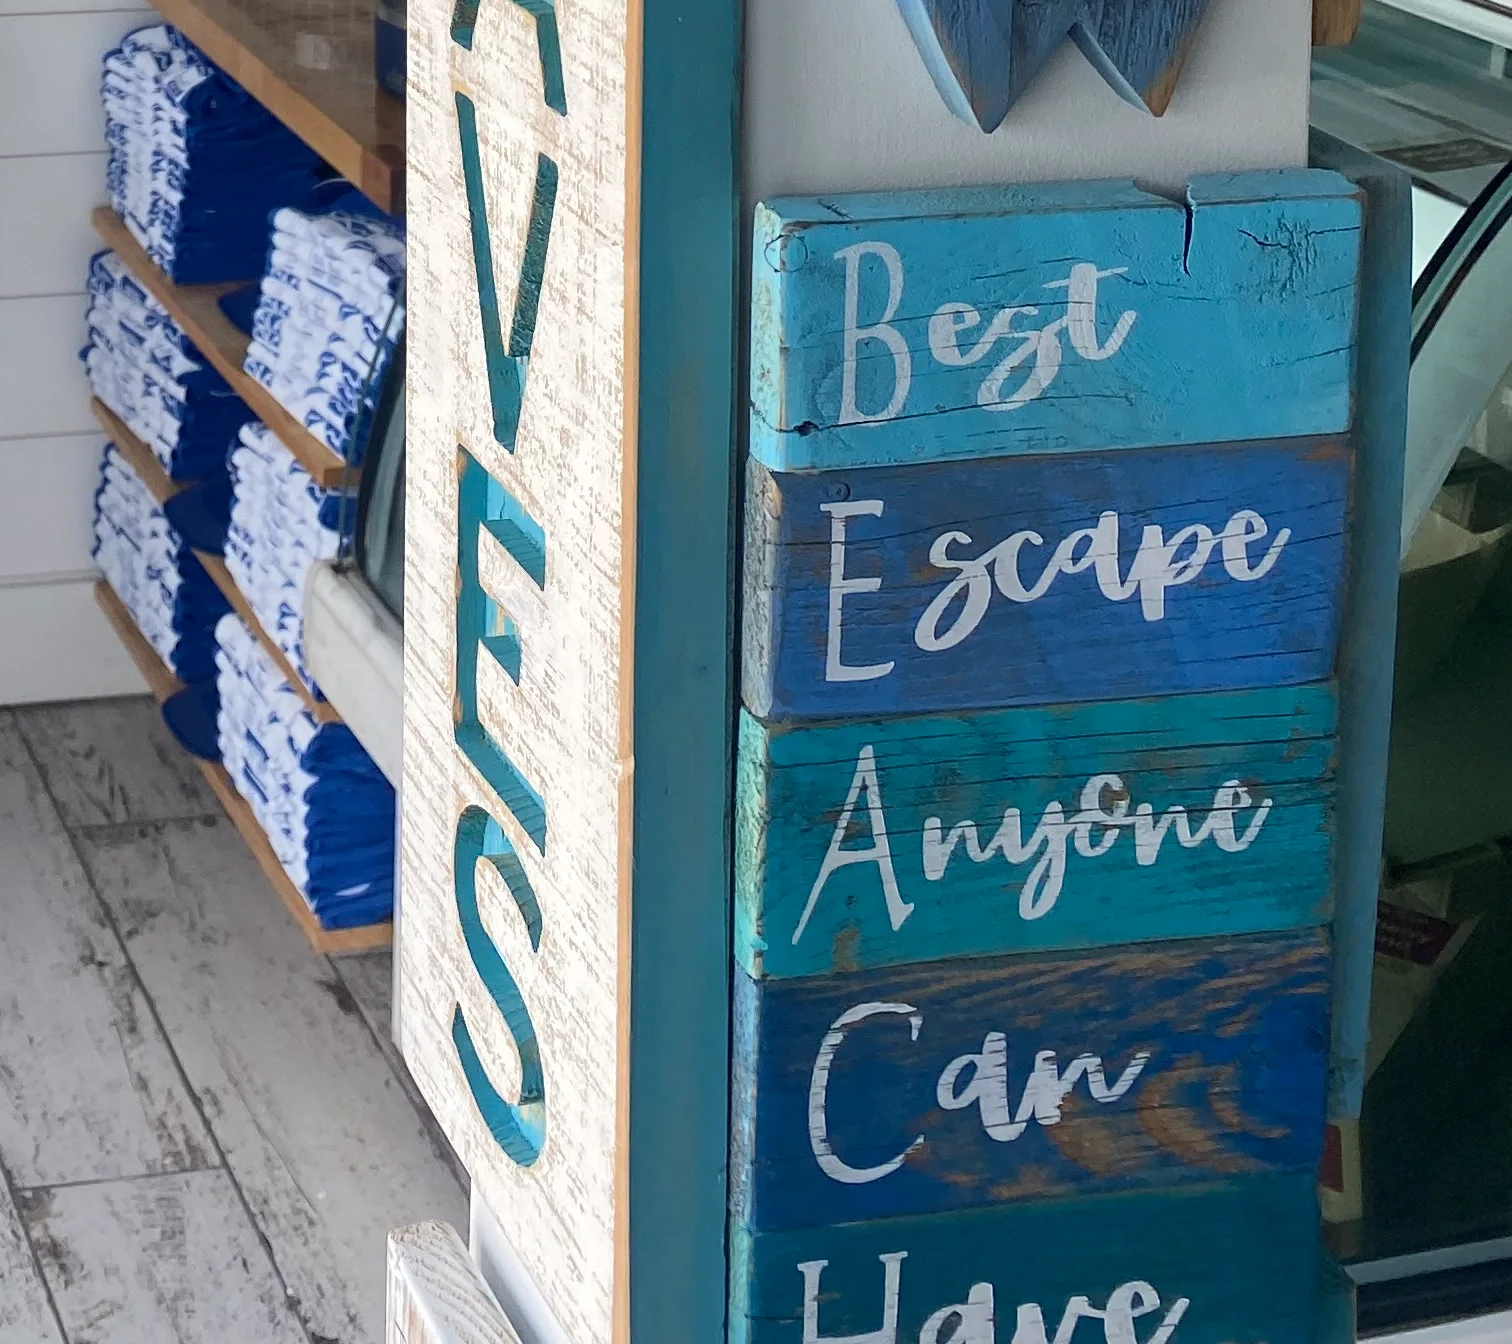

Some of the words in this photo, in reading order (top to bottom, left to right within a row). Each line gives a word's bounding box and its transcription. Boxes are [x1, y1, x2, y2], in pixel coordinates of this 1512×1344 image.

[833, 240, 1137, 427] Best
[819, 498, 1291, 684] Escape
[790, 744, 1274, 946] Anyone
[807, 1000, 1153, 1184] Can
